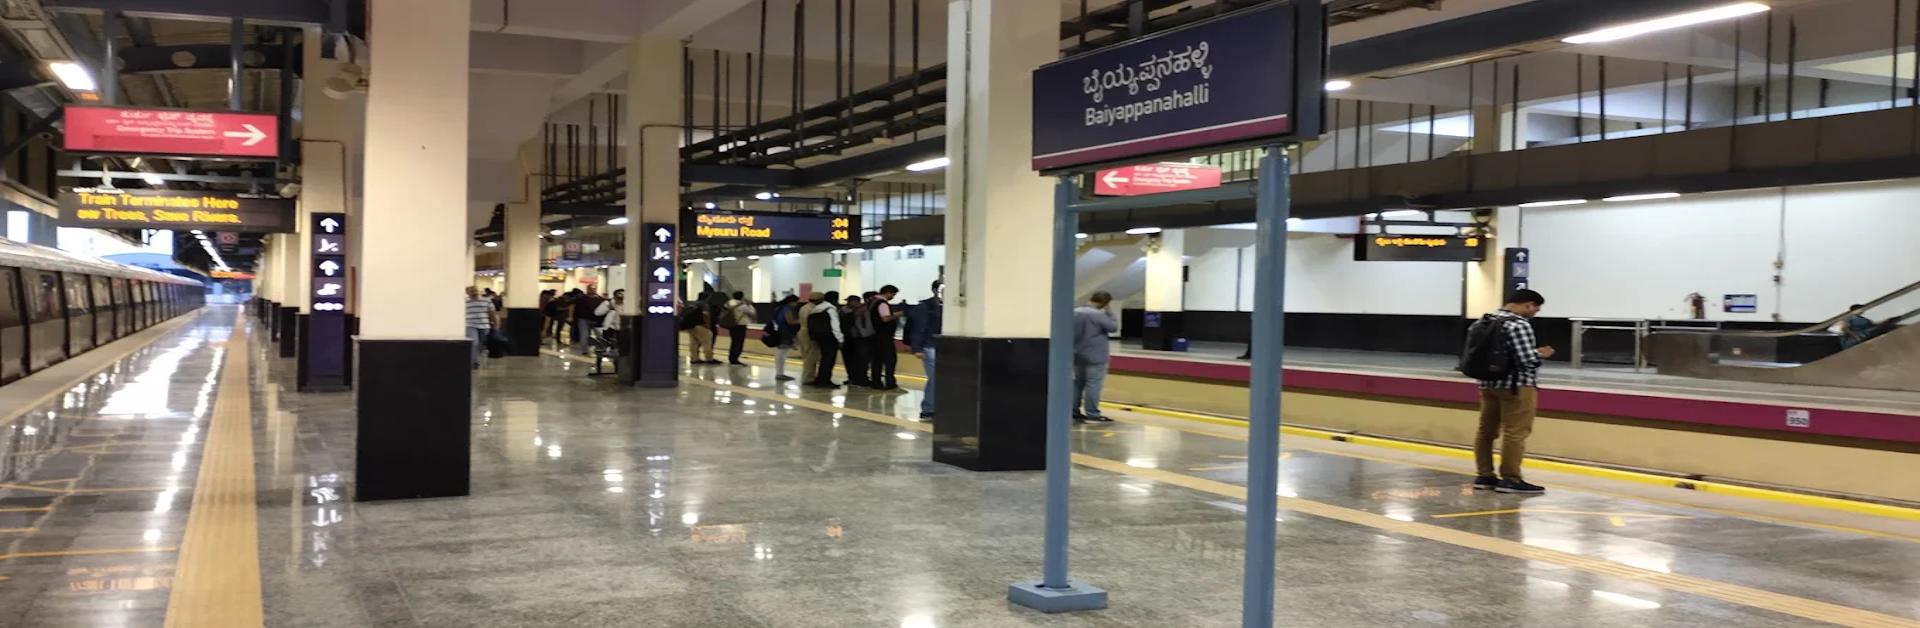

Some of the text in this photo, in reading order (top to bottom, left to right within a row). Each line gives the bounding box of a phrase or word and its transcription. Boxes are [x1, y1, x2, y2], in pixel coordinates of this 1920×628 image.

[1085, 83, 1209, 126] Baiyappanahalli
[79, 192, 239, 209] Train Terminates Here
[697, 225, 769, 238] Mysuru Road
